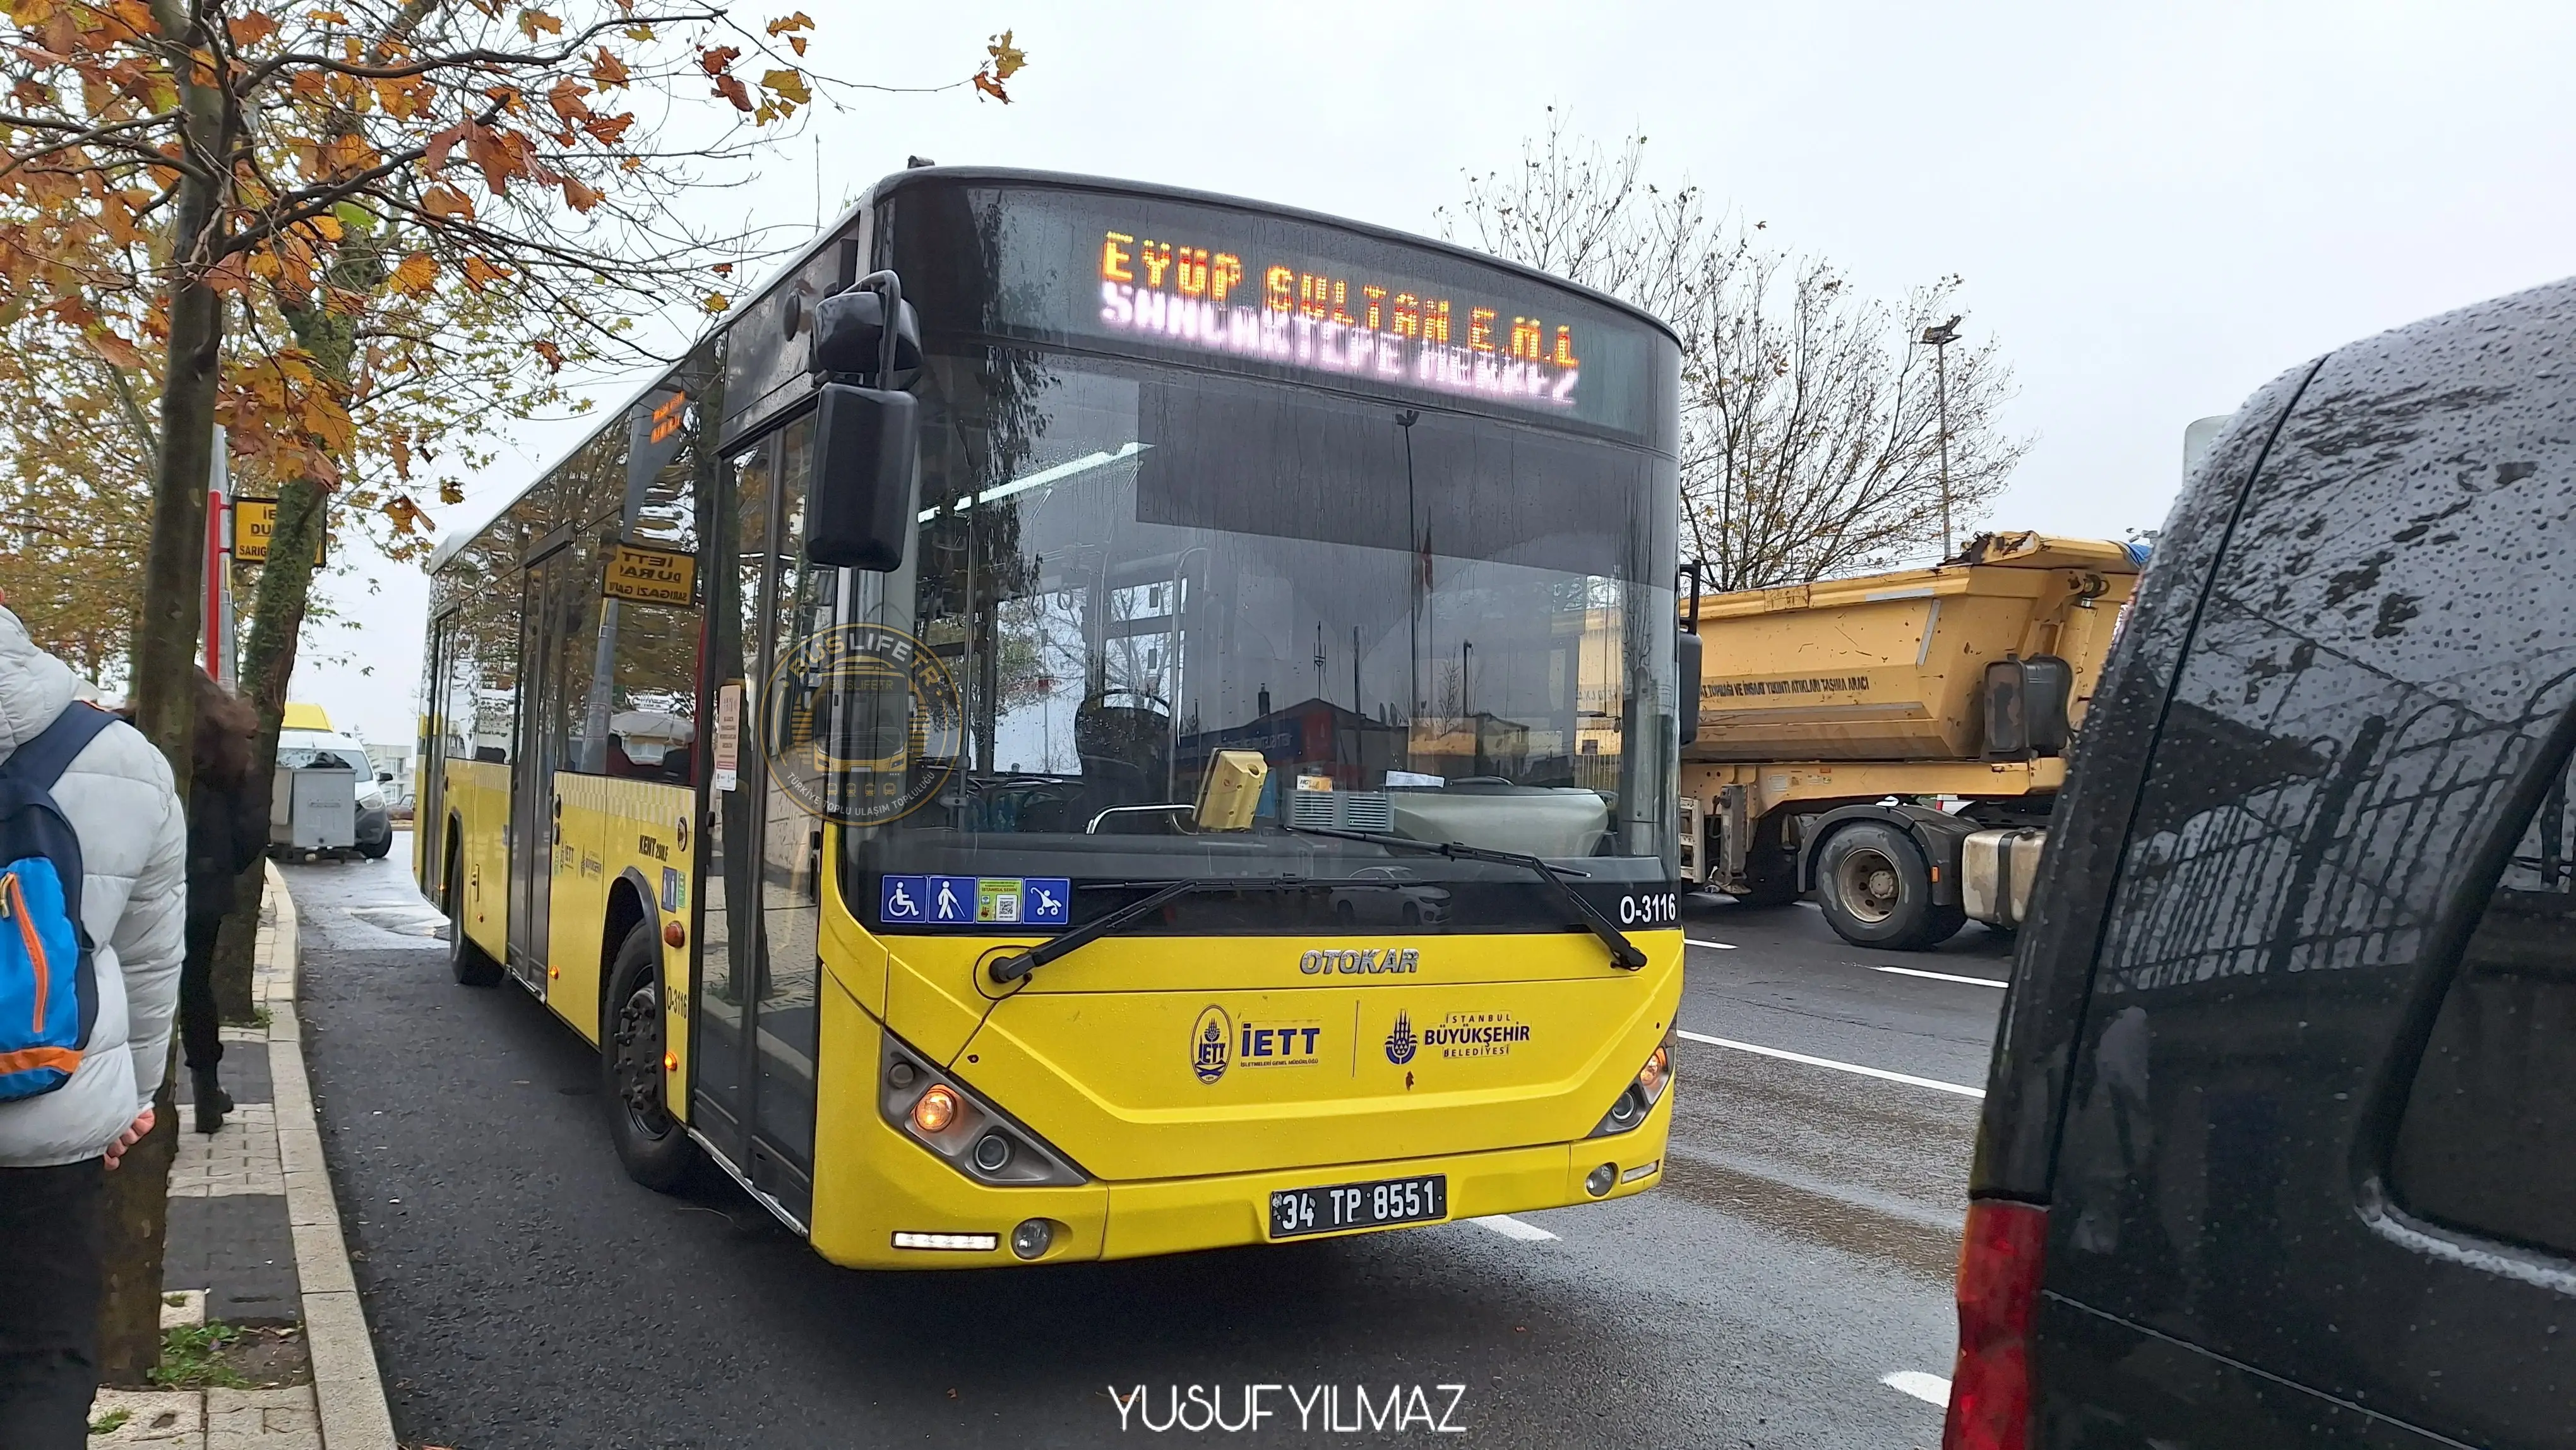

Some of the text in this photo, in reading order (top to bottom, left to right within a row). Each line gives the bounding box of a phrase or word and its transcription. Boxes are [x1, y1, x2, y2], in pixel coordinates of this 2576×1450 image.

[1102, 231, 1241, 303] EYÜP
[1265, 264, 1450, 344] SULTAN
[1848, 676, 1869, 691] ARACI
[639, 834, 657, 858] KENT
[1620, 893, 1676, 925] O-3116
[1299, 948, 1421, 975] OTOKAR
[667, 985, 687, 1019] O-3116
[1446, 1013, 1511, 1024] İSTANBUL
[1241, 1022, 1320, 1057] İETT
[1424, 1021, 1530, 1047] BÜYÜKŞEHİR
[1443, 1045, 1510, 1058] BELEDİYESİ
[1282, 1180, 1434, 1230] 34 TP 8551
